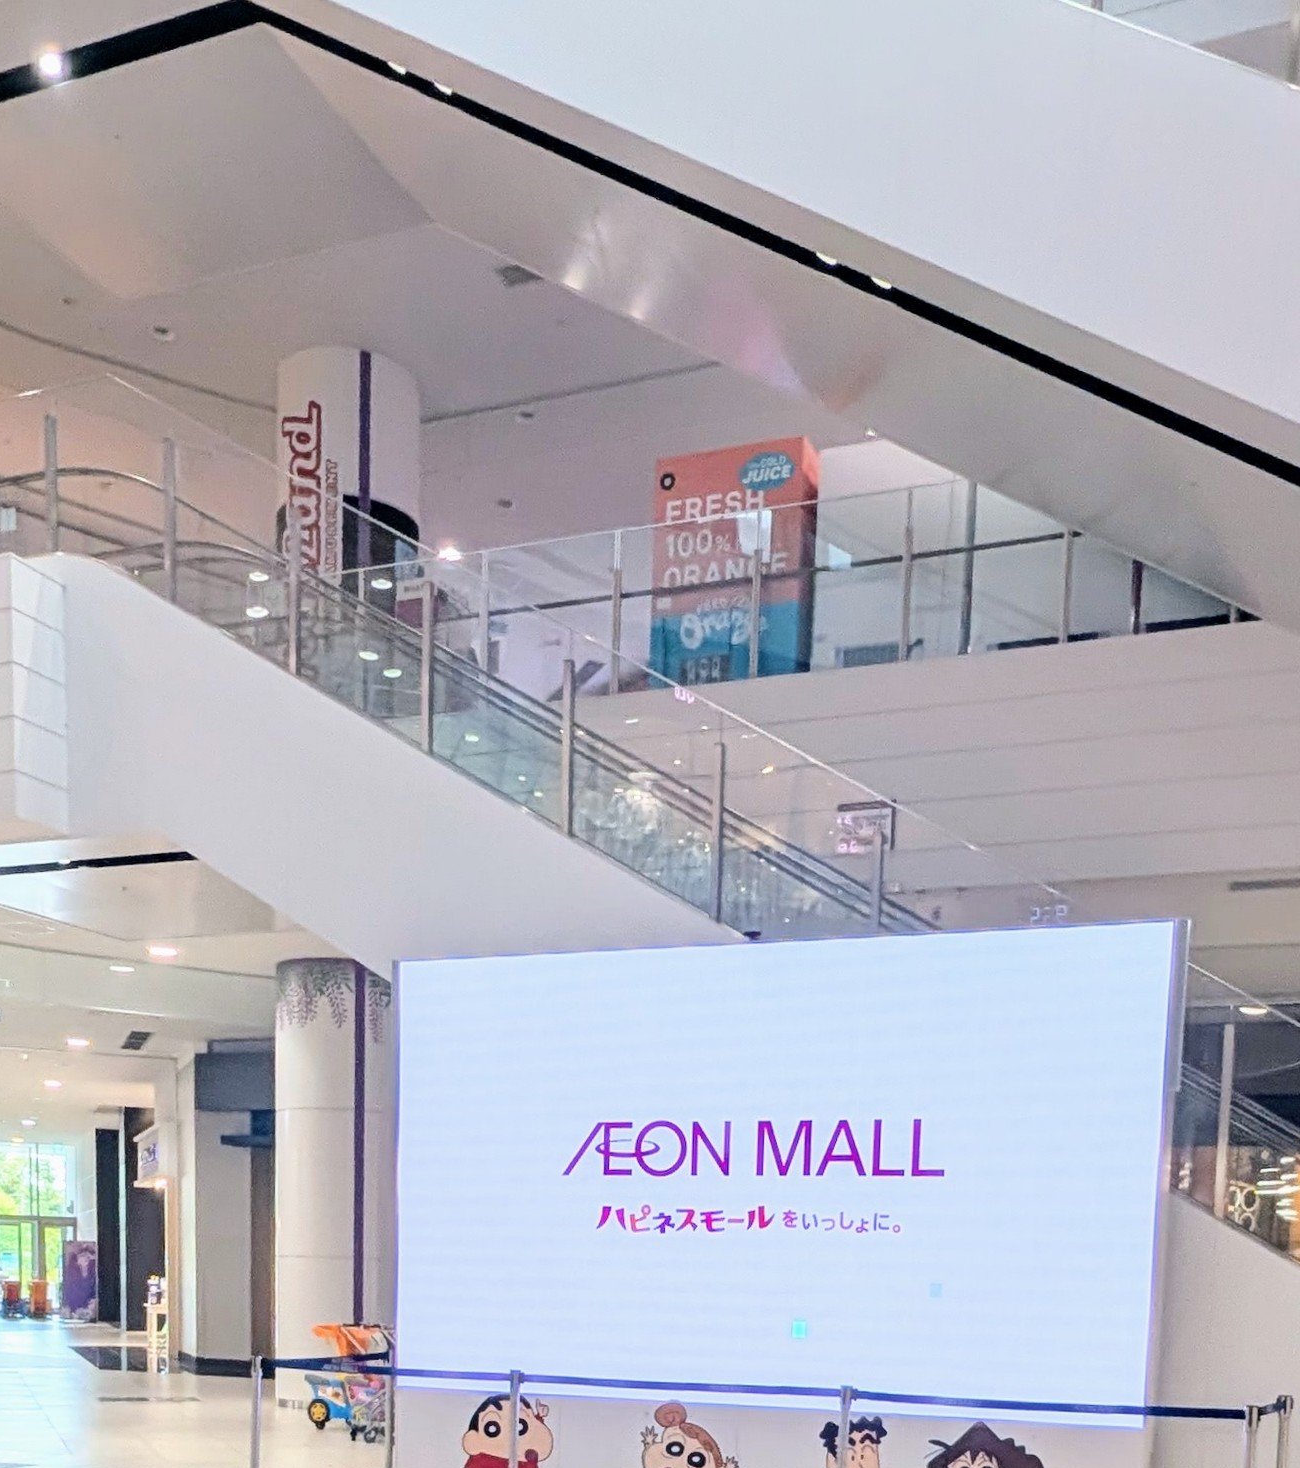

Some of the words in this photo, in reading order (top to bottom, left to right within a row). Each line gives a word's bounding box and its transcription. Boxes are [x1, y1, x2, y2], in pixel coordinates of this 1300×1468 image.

[741, 464, 792, 484] JUICE
[665, 490, 764, 525] FRESH
[666, 528, 731, 560] 100%
[755, 1118, 945, 1177] MALL
